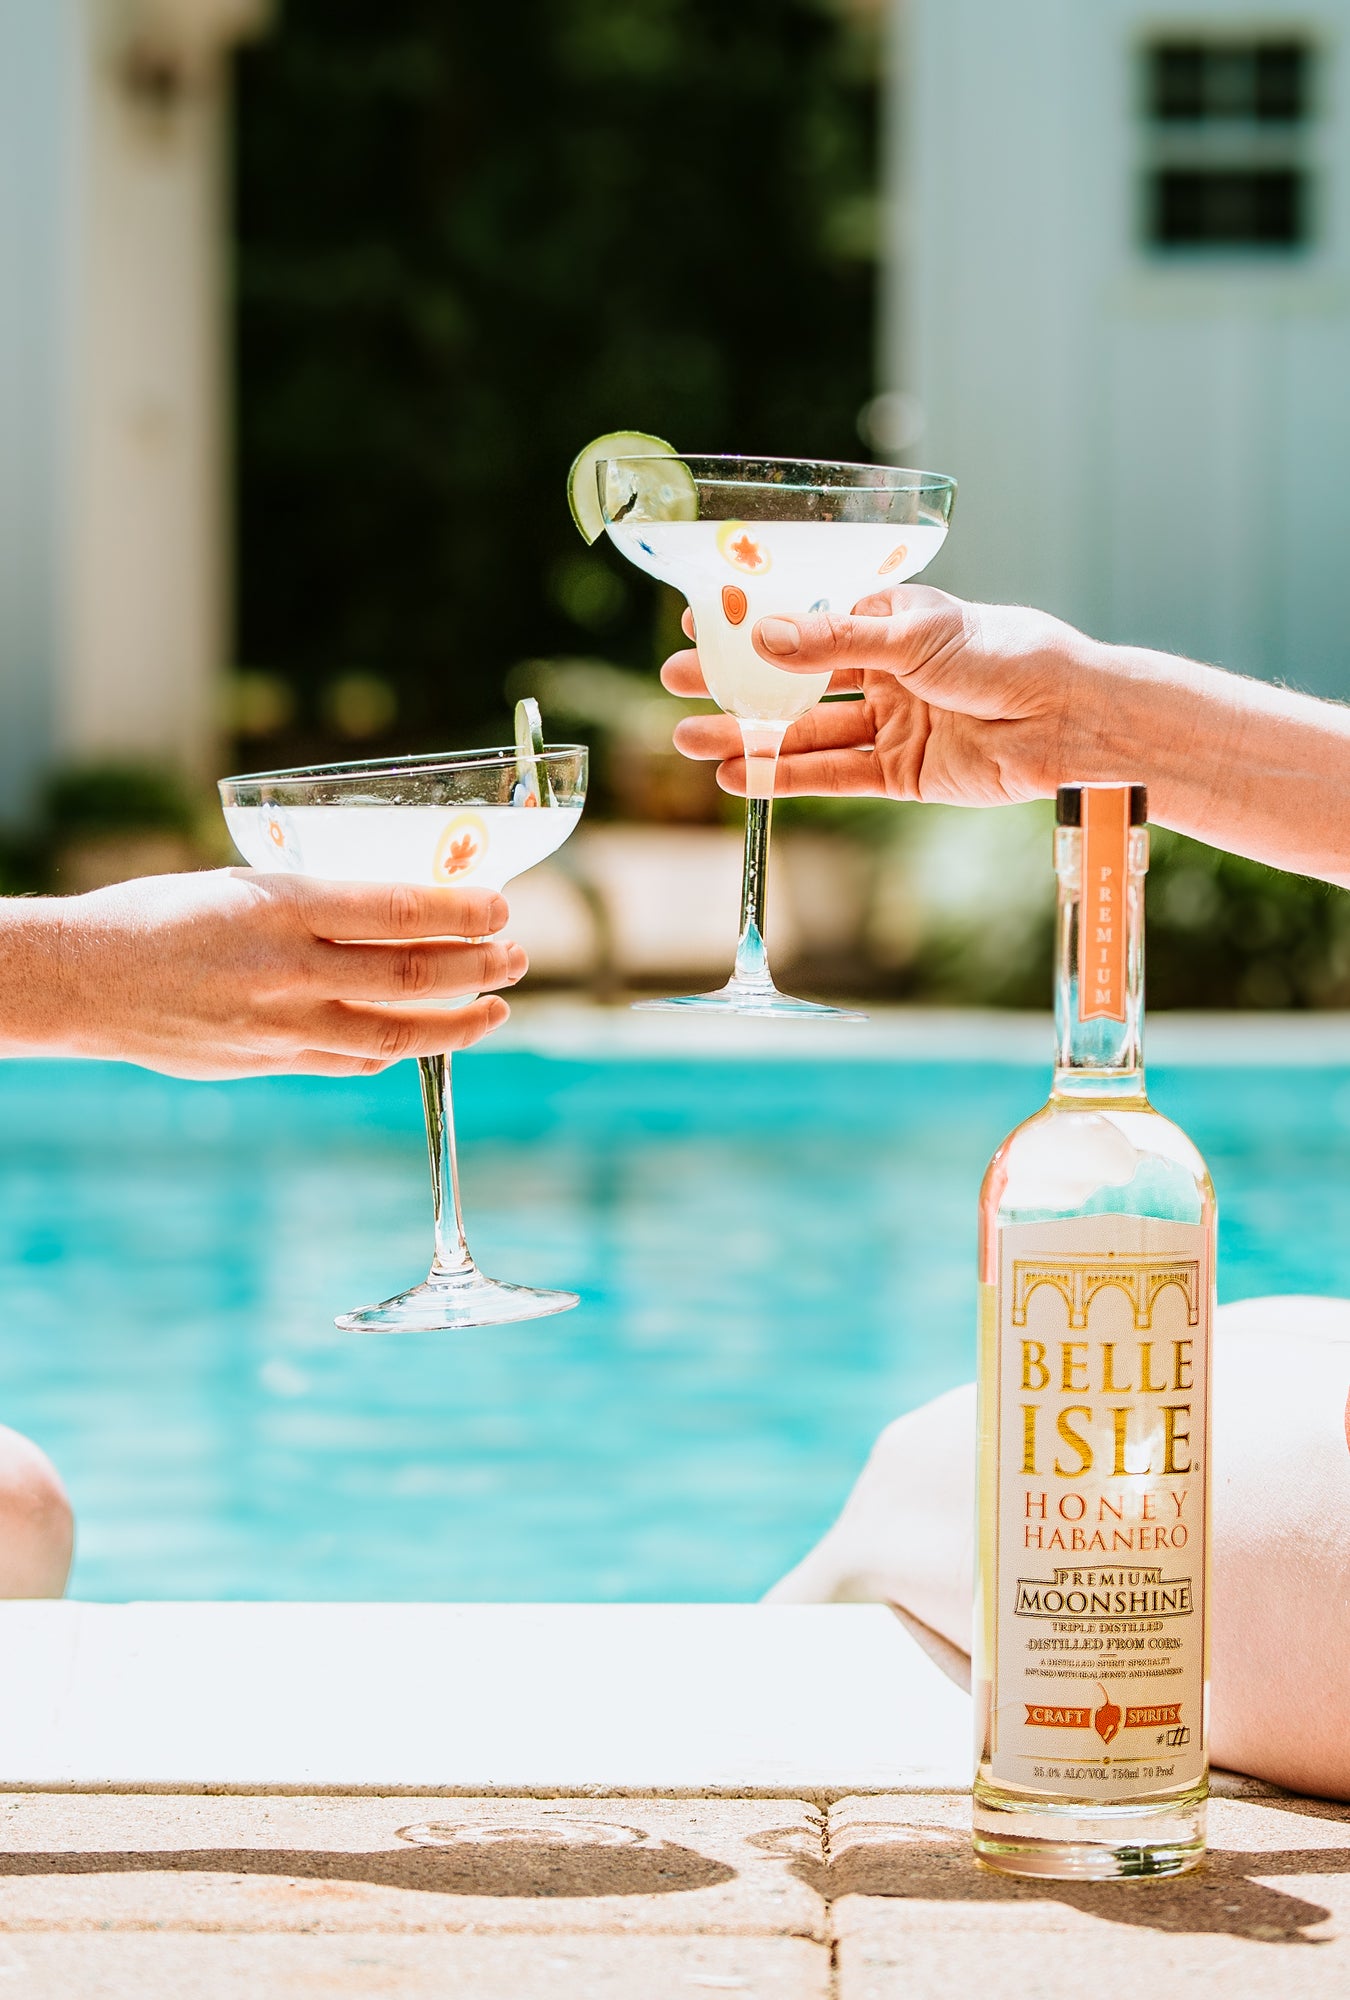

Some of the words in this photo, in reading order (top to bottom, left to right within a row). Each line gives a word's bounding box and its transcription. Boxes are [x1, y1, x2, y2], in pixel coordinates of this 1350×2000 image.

[1095, 865, 1113, 1005] PREMIUM
[1019, 1339, 1195, 1393] BELLE
[1018, 1403, 1192, 1479] ISLE
[1024, 1490, 1188, 1521] HONEY
[1023, 1523, 1189, 1551] HABANERO
[1058, 1571, 1158, 1586] PREMIUM
[1020, 1587, 1190, 1614] MOONSHINE
[1052, 1622, 1096, 1633] TRIPLE
[1100, 1621, 1163, 1633] DISTILLED
[1106, 1638, 1145, 1650] FROM
[1032, 1708, 1084, 1723] CRAFT
[1128, 1707, 1176, 1724] SPIRITS
